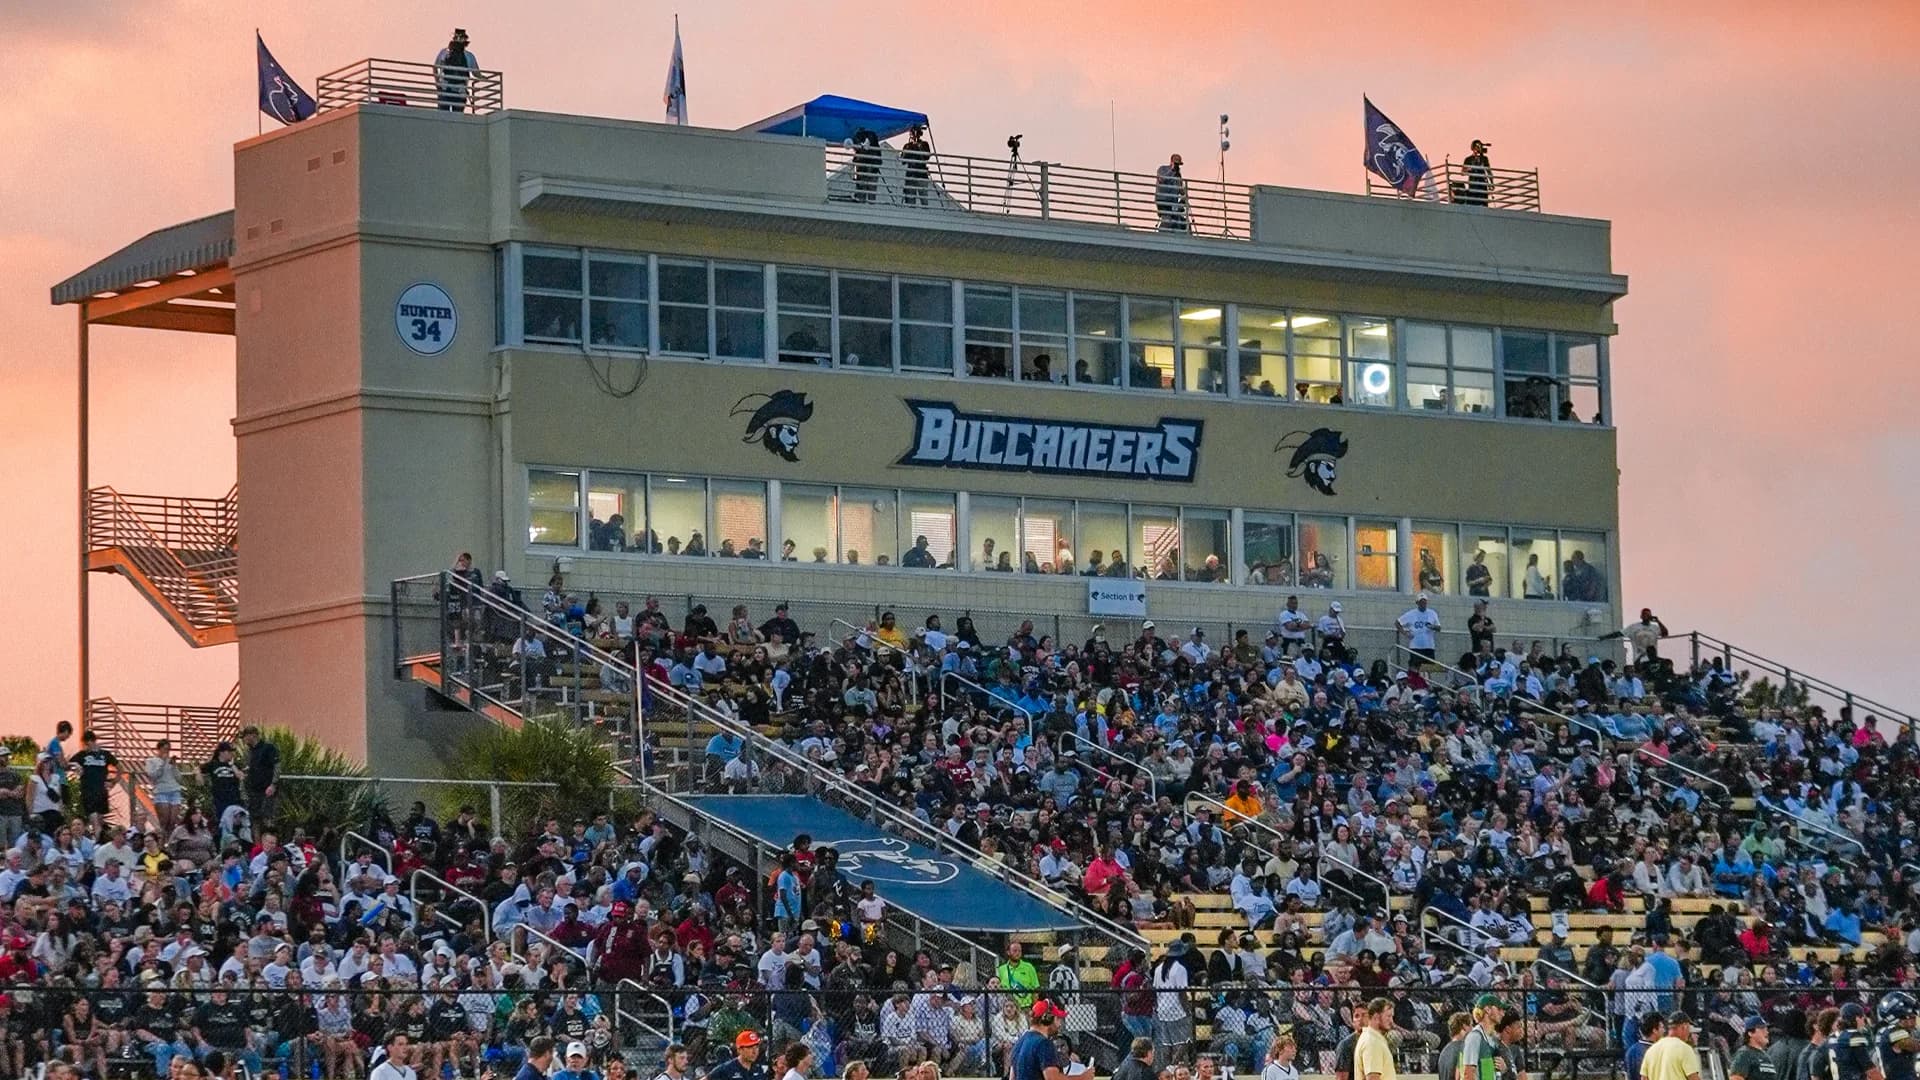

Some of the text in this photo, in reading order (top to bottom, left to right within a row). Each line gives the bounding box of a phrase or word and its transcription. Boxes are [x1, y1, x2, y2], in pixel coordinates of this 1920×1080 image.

[400, 304, 452, 319] HUNTER
[411, 318, 441, 342] 34
[911, 406, 1196, 477] BUCCANEERS
[1100, 592, 1127, 600] Section
